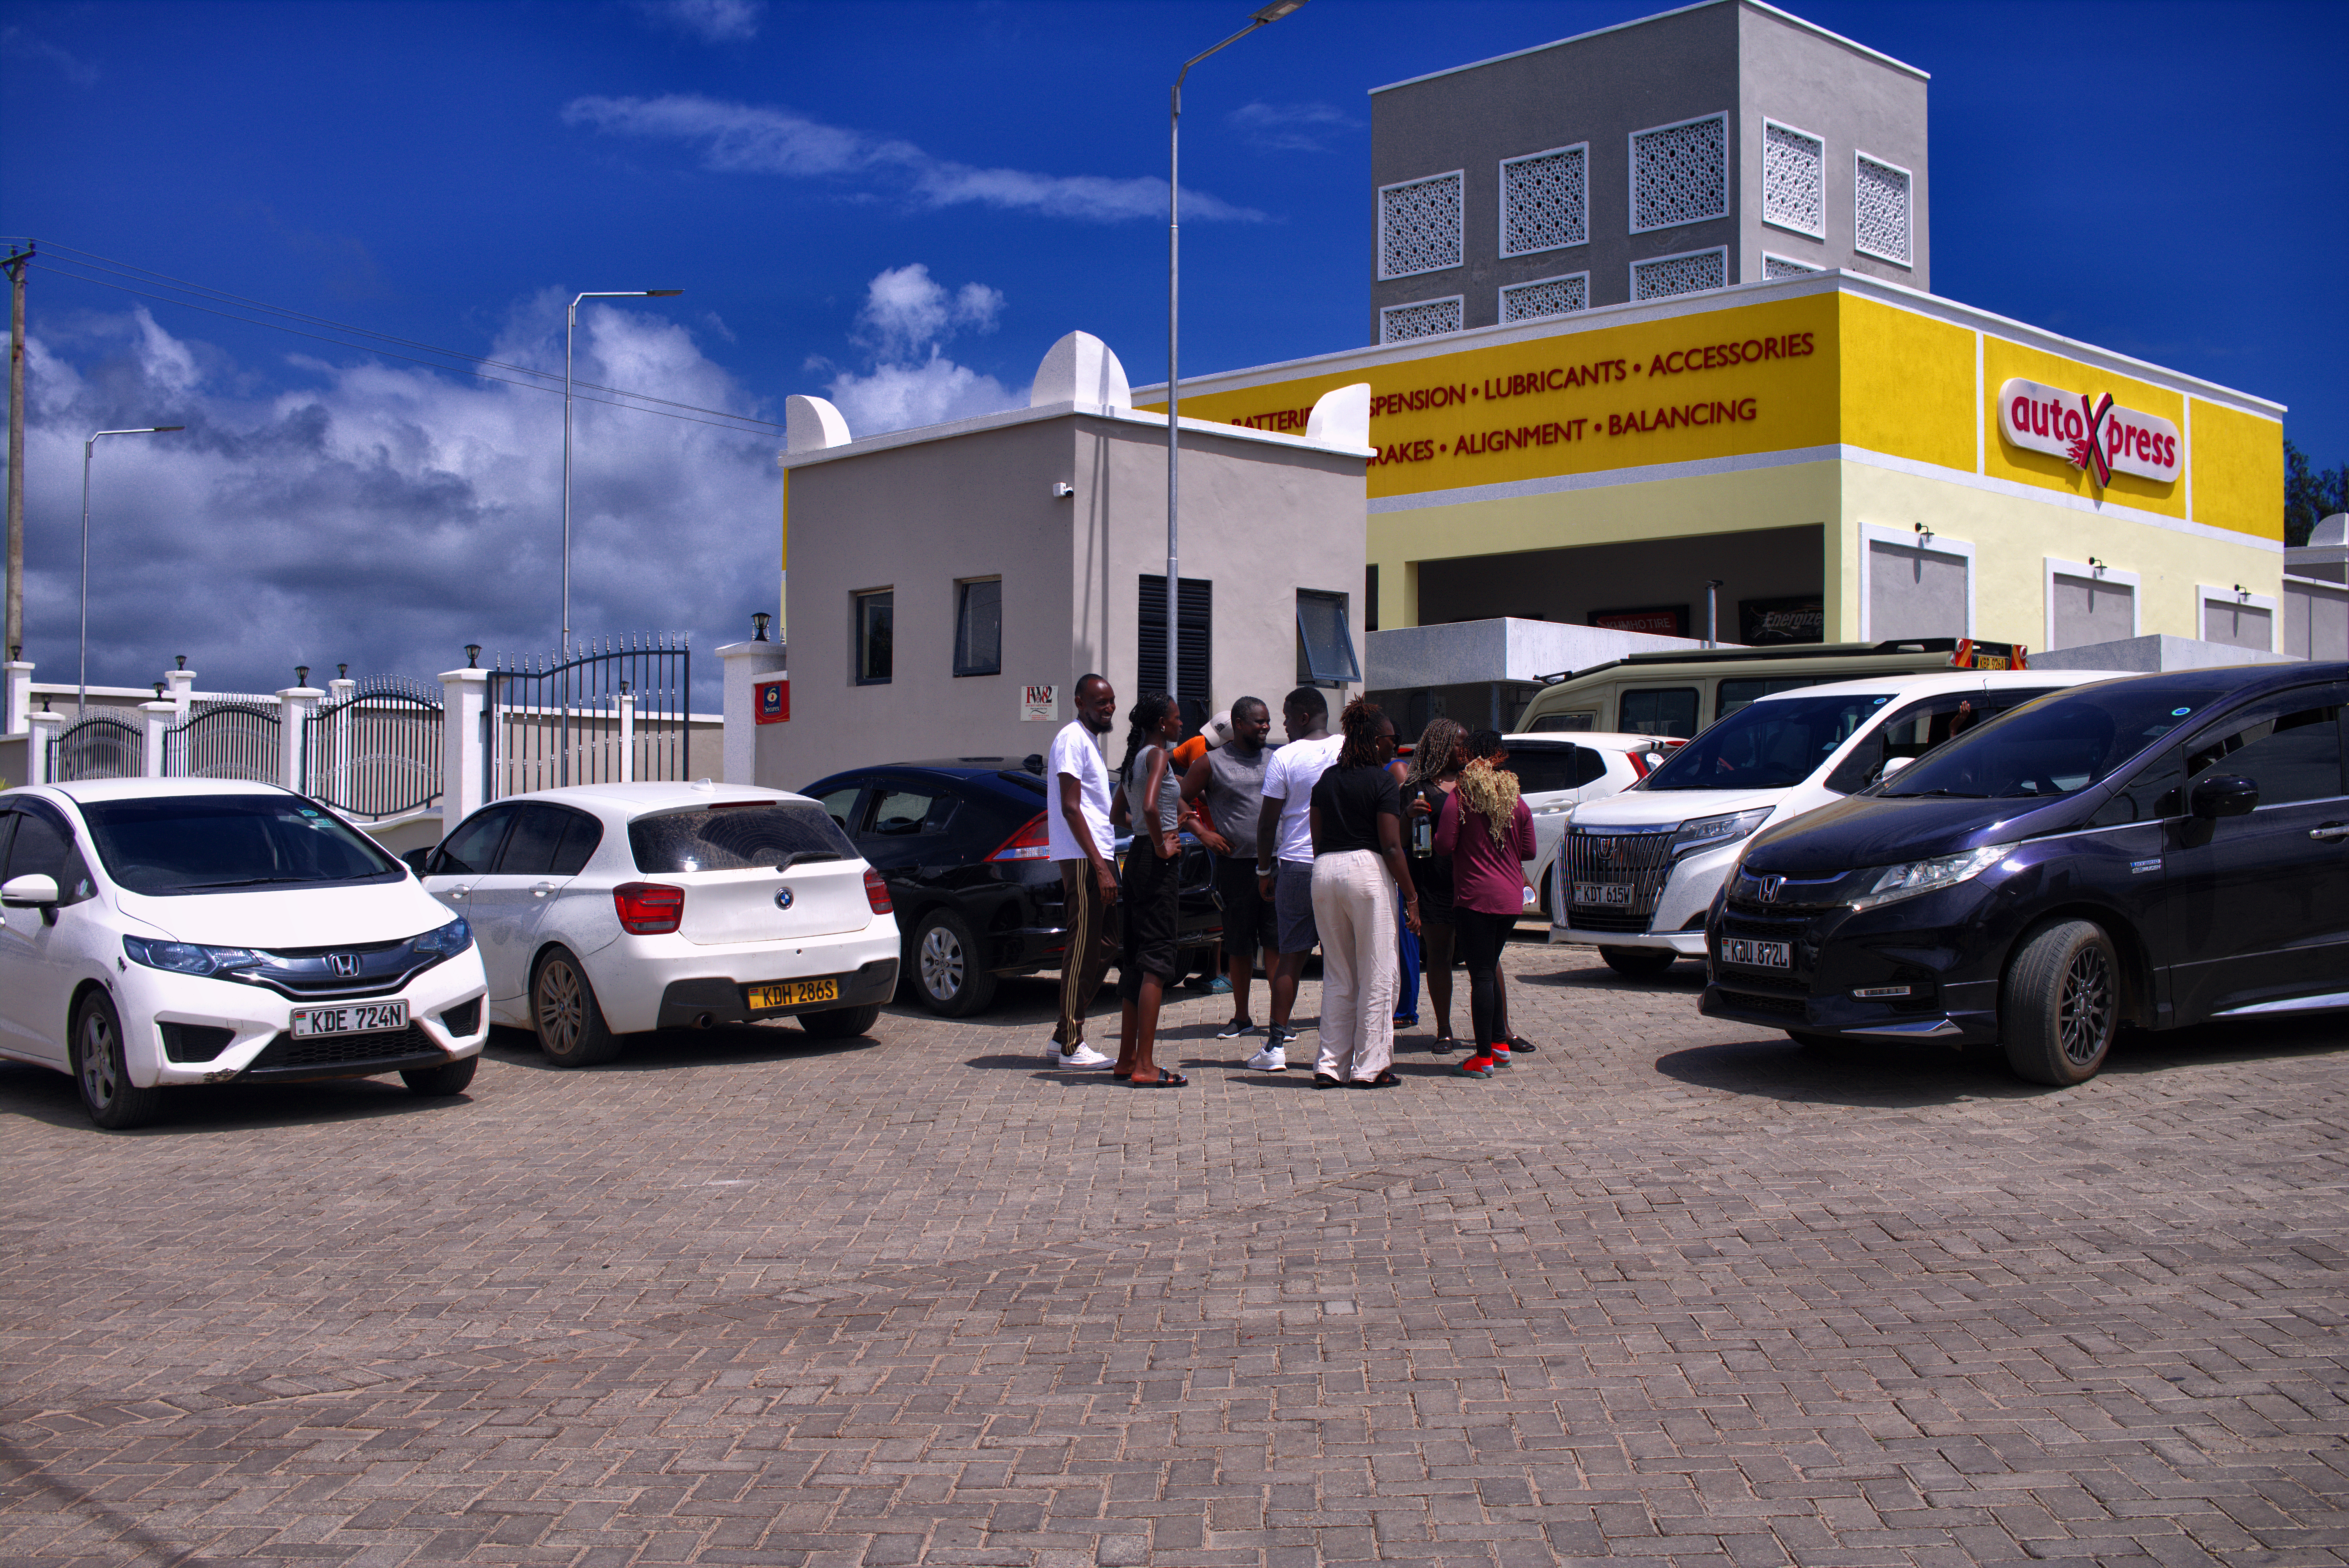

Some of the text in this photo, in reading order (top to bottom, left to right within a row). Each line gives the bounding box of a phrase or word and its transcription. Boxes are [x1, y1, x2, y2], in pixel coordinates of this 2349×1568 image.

[1485, 359, 1626, 400] LUBRICANTS
[1648, 333, 1814, 377] ACCESSORIES
[1366, 398, 1757, 467] RAKES ALIGNMENT BALANCING
[2011, 392, 2175, 488] autoXpress
[1606, 618, 1671, 630] KUMHO TIRE
[1763, 611, 1824, 630] Energize
[1980, 657, 2004, 670] KBP 926A
[1584, 886, 1602, 902] KDT
[1731, 940, 1787, 966] KDU 872L
[763, 980, 834, 1007] KDH 286S
[312, 1005, 401, 1034] KDE 724N
